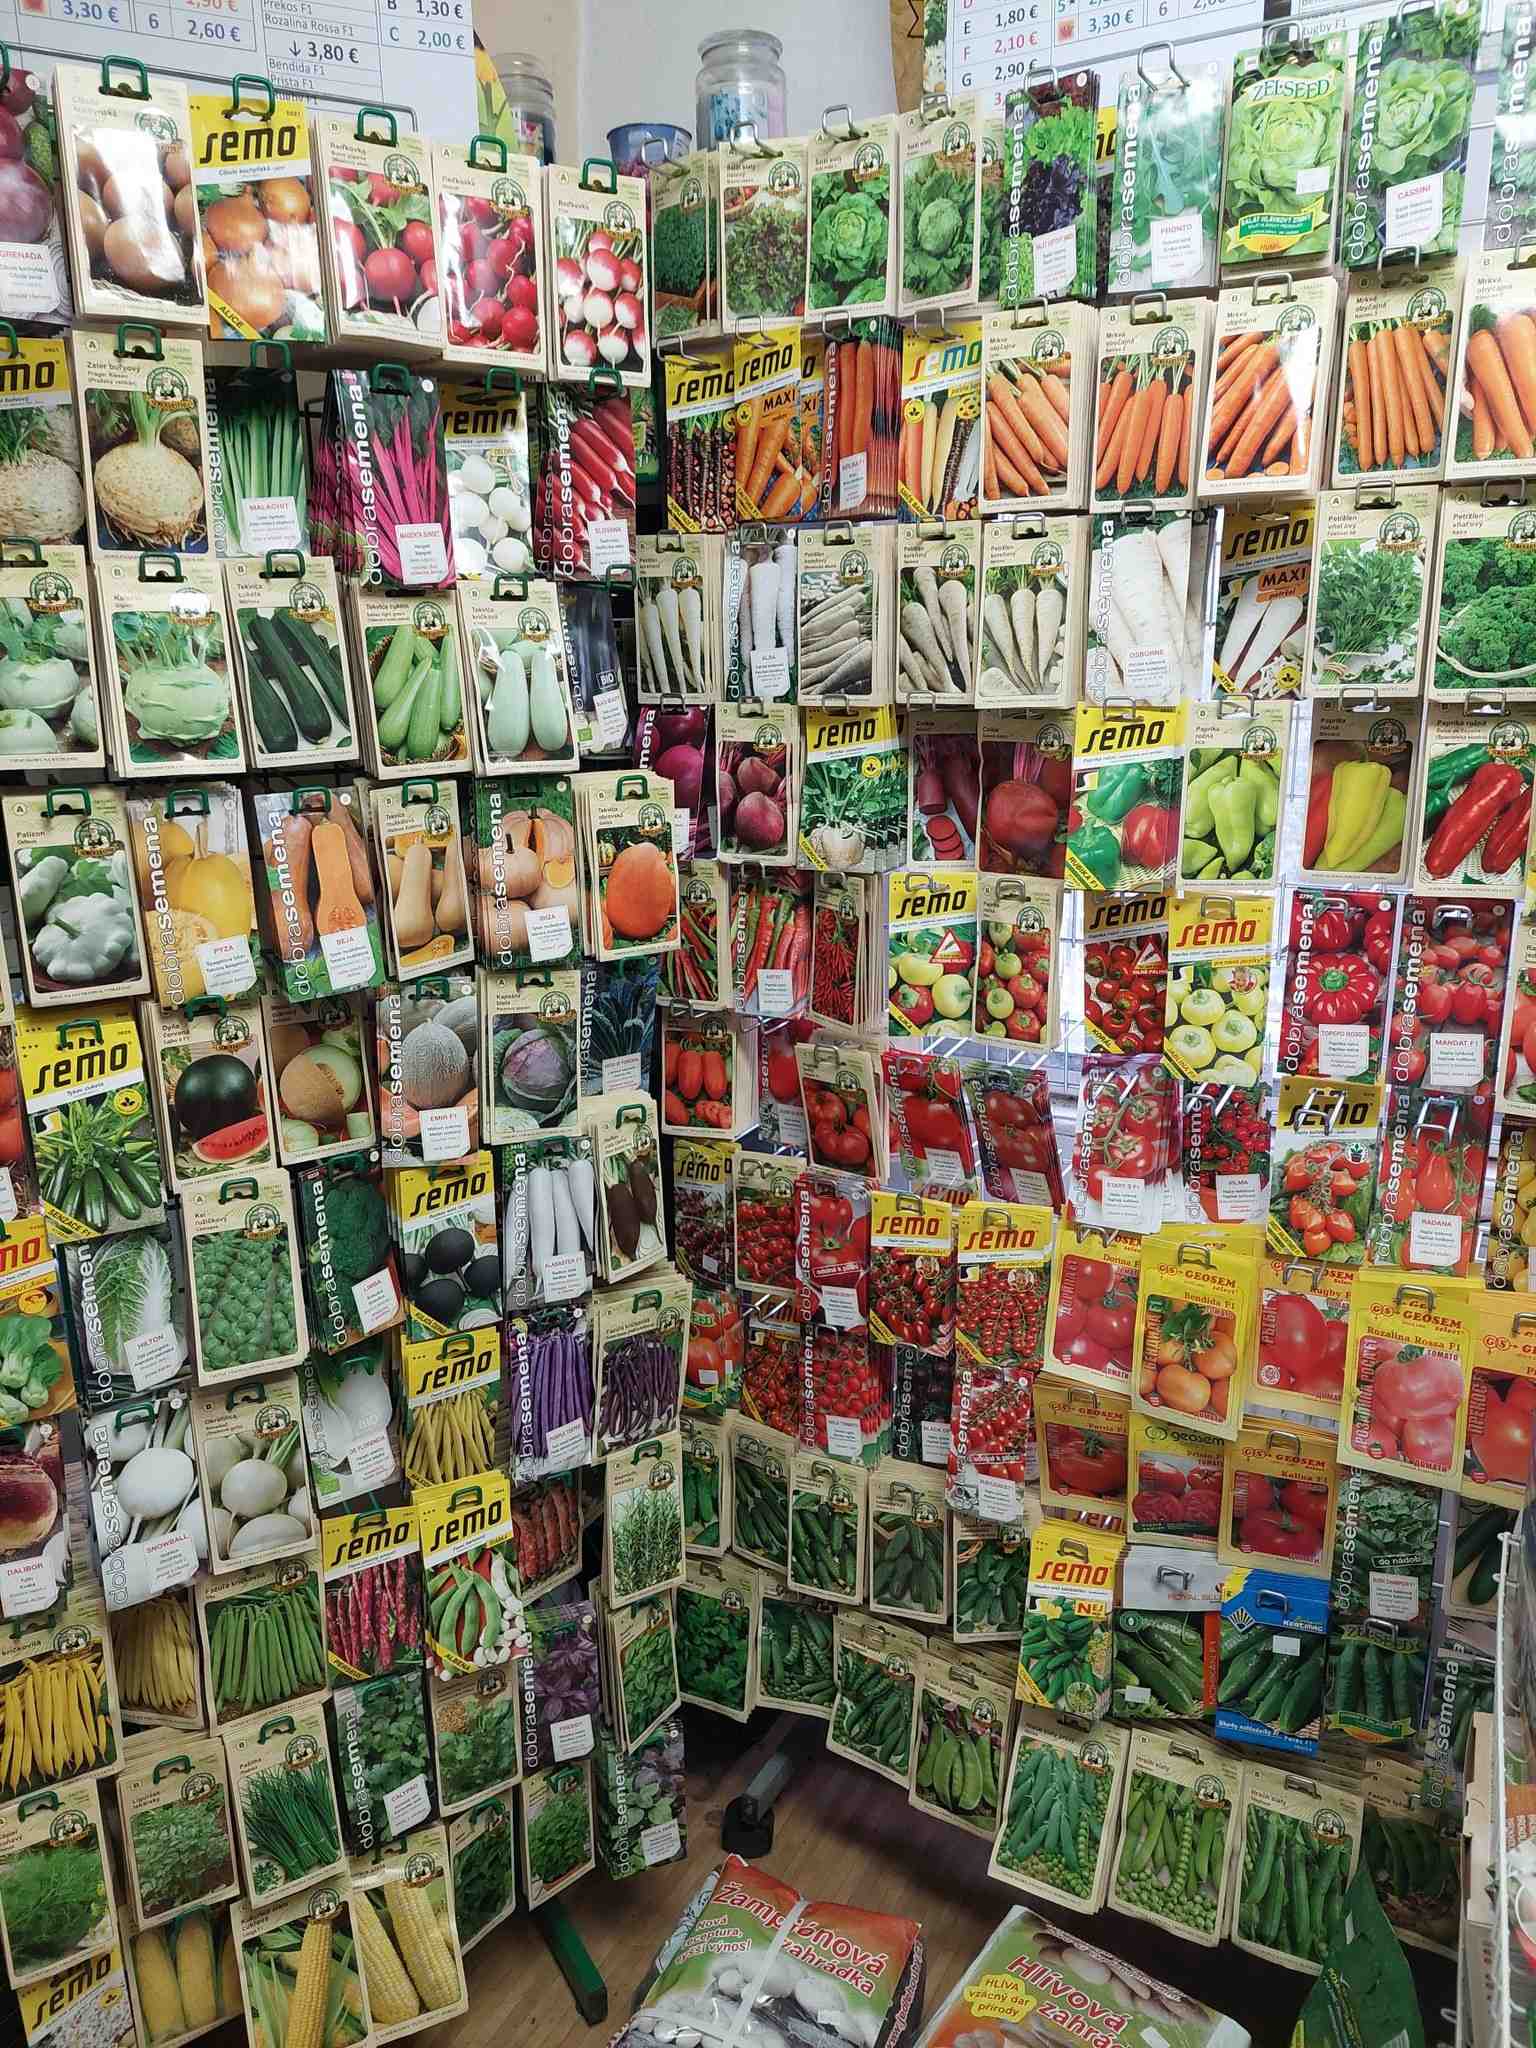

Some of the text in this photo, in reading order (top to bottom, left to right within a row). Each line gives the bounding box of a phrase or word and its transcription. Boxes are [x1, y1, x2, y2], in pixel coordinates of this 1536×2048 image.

[64, 0, 119, 23] 3,30 €
[150, 14, 159, 29] 6
[416, 0, 449, 17] 1,30
[454, 3, 463, 19] €
[963, 6, 1038, 34] E 1,80 €
[1088, 10, 1134, 33] 3,30 €
[1159, 1, 1168, 17] 6
[187, 20, 240, 42] 2,60 €
[265, 14, 354, 36] Rozalina Rossa F1
[390, 26, 465, 49] C 2,00 €
[307, 42, 359, 63] 3,80 €
[963, 32, 1038, 61] F 2,10 €
[269, 59, 325, 75] Bendida F1
[271, 75, 314, 89] Prista F1
[962, 72, 972, 88] G
[994, 61, 1025, 81] 2,90
[200, 125, 296, 165] semo
[1351, 36, 1384, 261] dobrasemena
[1006, 101, 1026, 300] dobrasemena
[738, 344, 794, 389] semo
[908, 334, 983, 382] semo
[762, 388, 797, 411] MAXI
[820, 342, 838, 513] dobrasemena
[350, 380, 384, 587] dobrasemena
[556, 390, 574, 577] dobrasemena
[1224, 518, 1310, 562] semo
[1261, 566, 1307, 589] MAXI
[729, 541, 742, 699] dobrasemena
[598, 672, 615, 686] BIO
[813, 718, 876, 750] semo
[1081, 720, 1167, 755] semo
[490, 793, 513, 966] dobrasemena
[144, 815, 186, 1006] dobrasemena
[267, 811, 309, 996] dobrasemena
[895, 889, 967, 920] semo
[1088, 895, 1167, 930] semo
[1175, 918, 1257, 949] semo
[1284, 901, 1315, 1072] dobrasemena
[1395, 908, 1426, 1082] dobrasemena
[33, 1041, 129, 1096] semo
[409, 1171, 488, 1219] semo
[1493, 1129, 1526, 1289] dobrasemena
[875, 1214, 941, 1238] semo
[965, 1229, 1037, 1251] semo
[312, 1179, 348, 1346] dobrasemena
[1185, 1270, 1236, 1288] GEOSEM
[1403, 1310, 1462, 1329] GEOSEM
[416, 1349, 494, 1396] semo
[1170, 1431, 1225, 1446] geosem
[1275, 1453, 1326, 1468] GEOSEM
[93, 1424, 129, 1605] dobrasemena
[430, 1498, 503, 1552] semo
[331, 1519, 411, 1567] semo
[1035, 1560, 1110, 1588] semo
[782, 1939, 875, 1998] zahrádka
[32, 1952, 114, 2030] semo
[968, 1990, 1030, 2007] vzácný dar
[984, 1978, 1020, 1992] HLÍVA
[1007, 1954, 1132, 2034] Hlívová
[976, 2003, 1020, 2017] přírody
